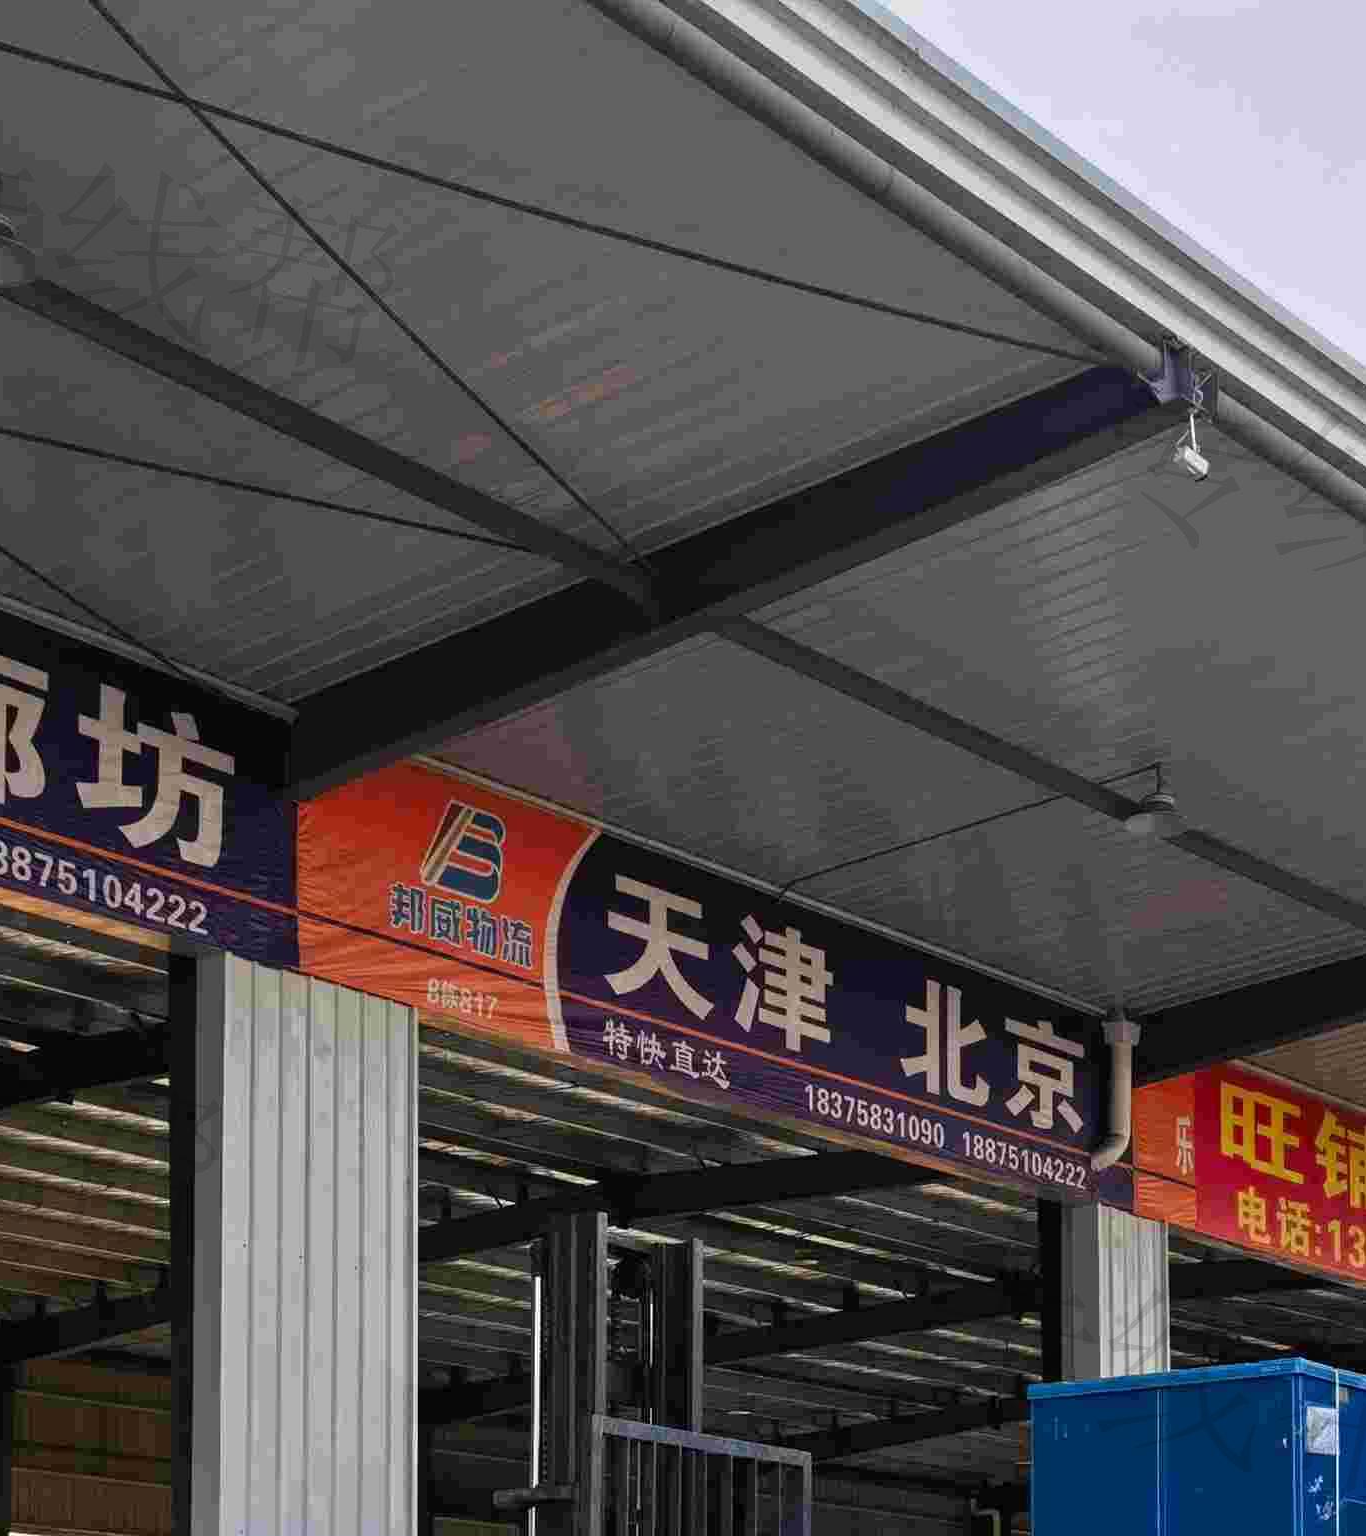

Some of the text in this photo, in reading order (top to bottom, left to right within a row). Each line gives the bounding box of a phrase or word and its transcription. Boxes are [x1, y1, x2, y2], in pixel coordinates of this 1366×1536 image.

[388, 881, 533, 970] 邦威物流
[604, 873, 1085, 1134] 天津 北京
[602, 1018, 731, 1090] 特快直达
[805, 1084, 1085, 1190] 18375831090 18875104222
